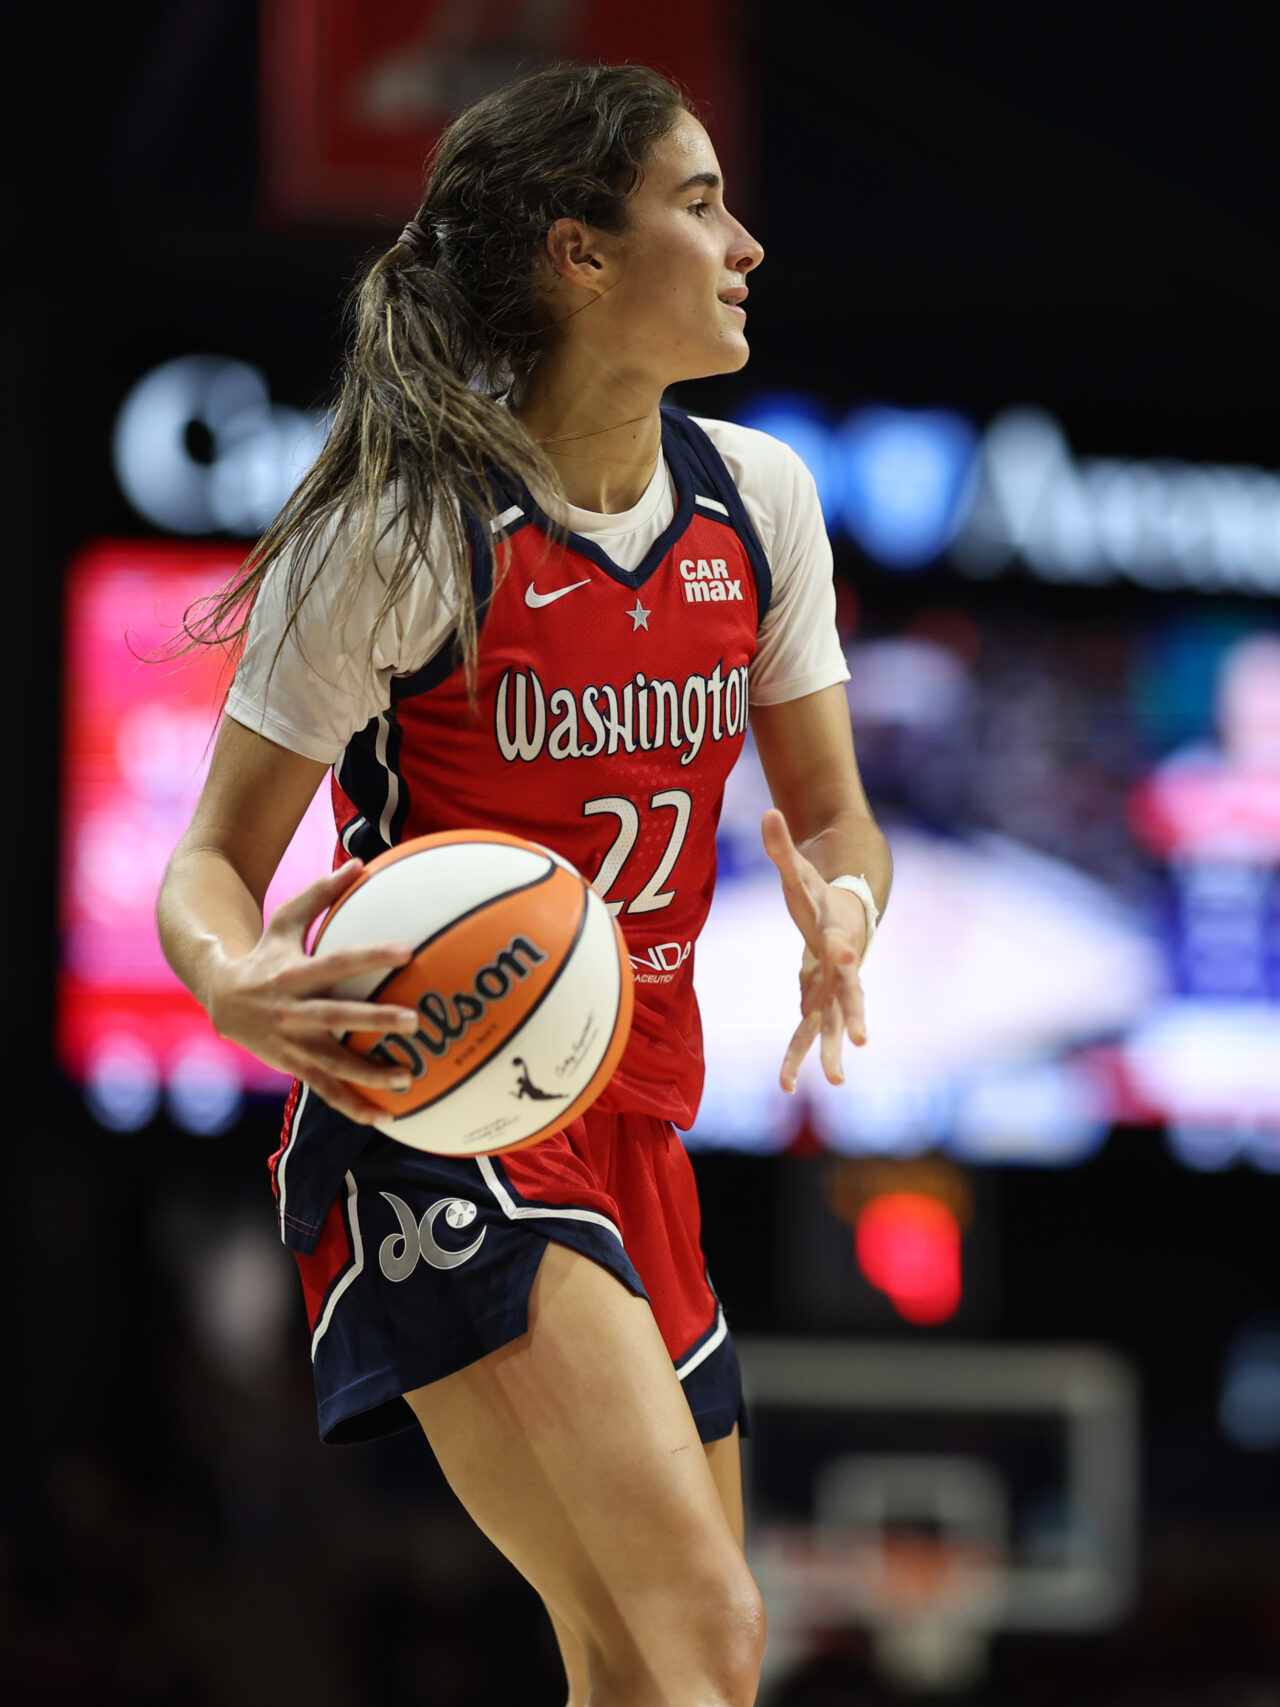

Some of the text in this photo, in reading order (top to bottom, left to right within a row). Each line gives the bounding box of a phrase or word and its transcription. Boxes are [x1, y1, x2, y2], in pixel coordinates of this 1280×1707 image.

[679, 558, 729, 580] CAR
[684, 579, 744, 602] max
[494, 657, 750, 766] Washington
[582, 788, 692, 917] 22
[629, 941, 691, 971] NDA
